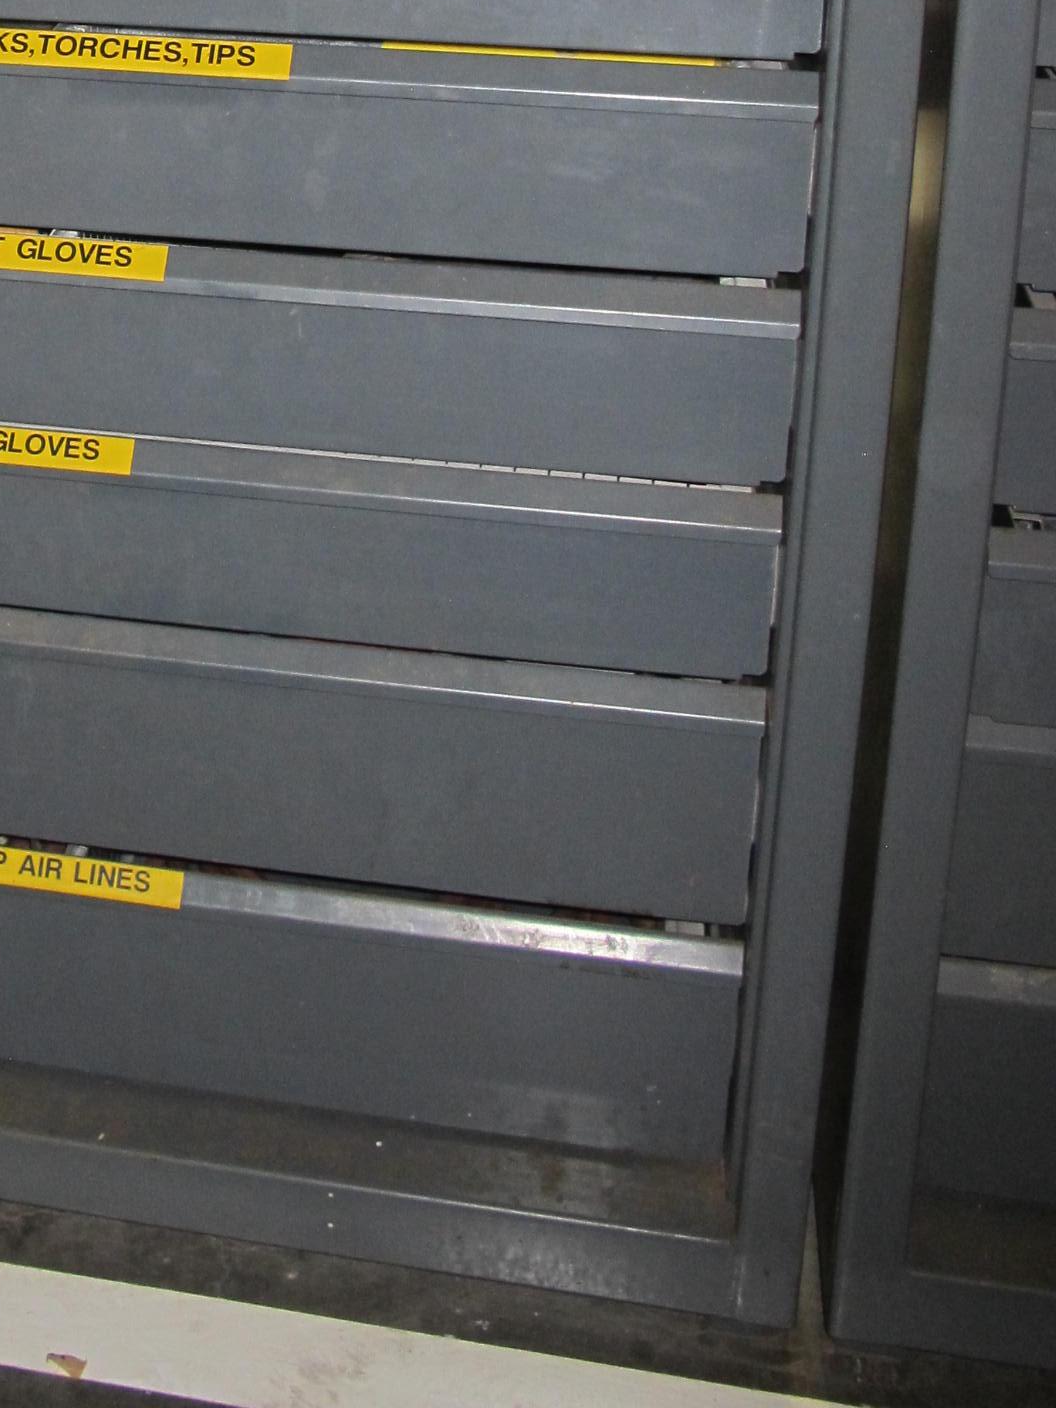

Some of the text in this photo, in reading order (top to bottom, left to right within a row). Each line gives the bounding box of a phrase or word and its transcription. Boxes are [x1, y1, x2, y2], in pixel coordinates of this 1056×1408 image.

[16, 238, 133, 267] GLOVES
[18, 855, 63, 880] AIR
[73, 861, 151, 893] LINES
